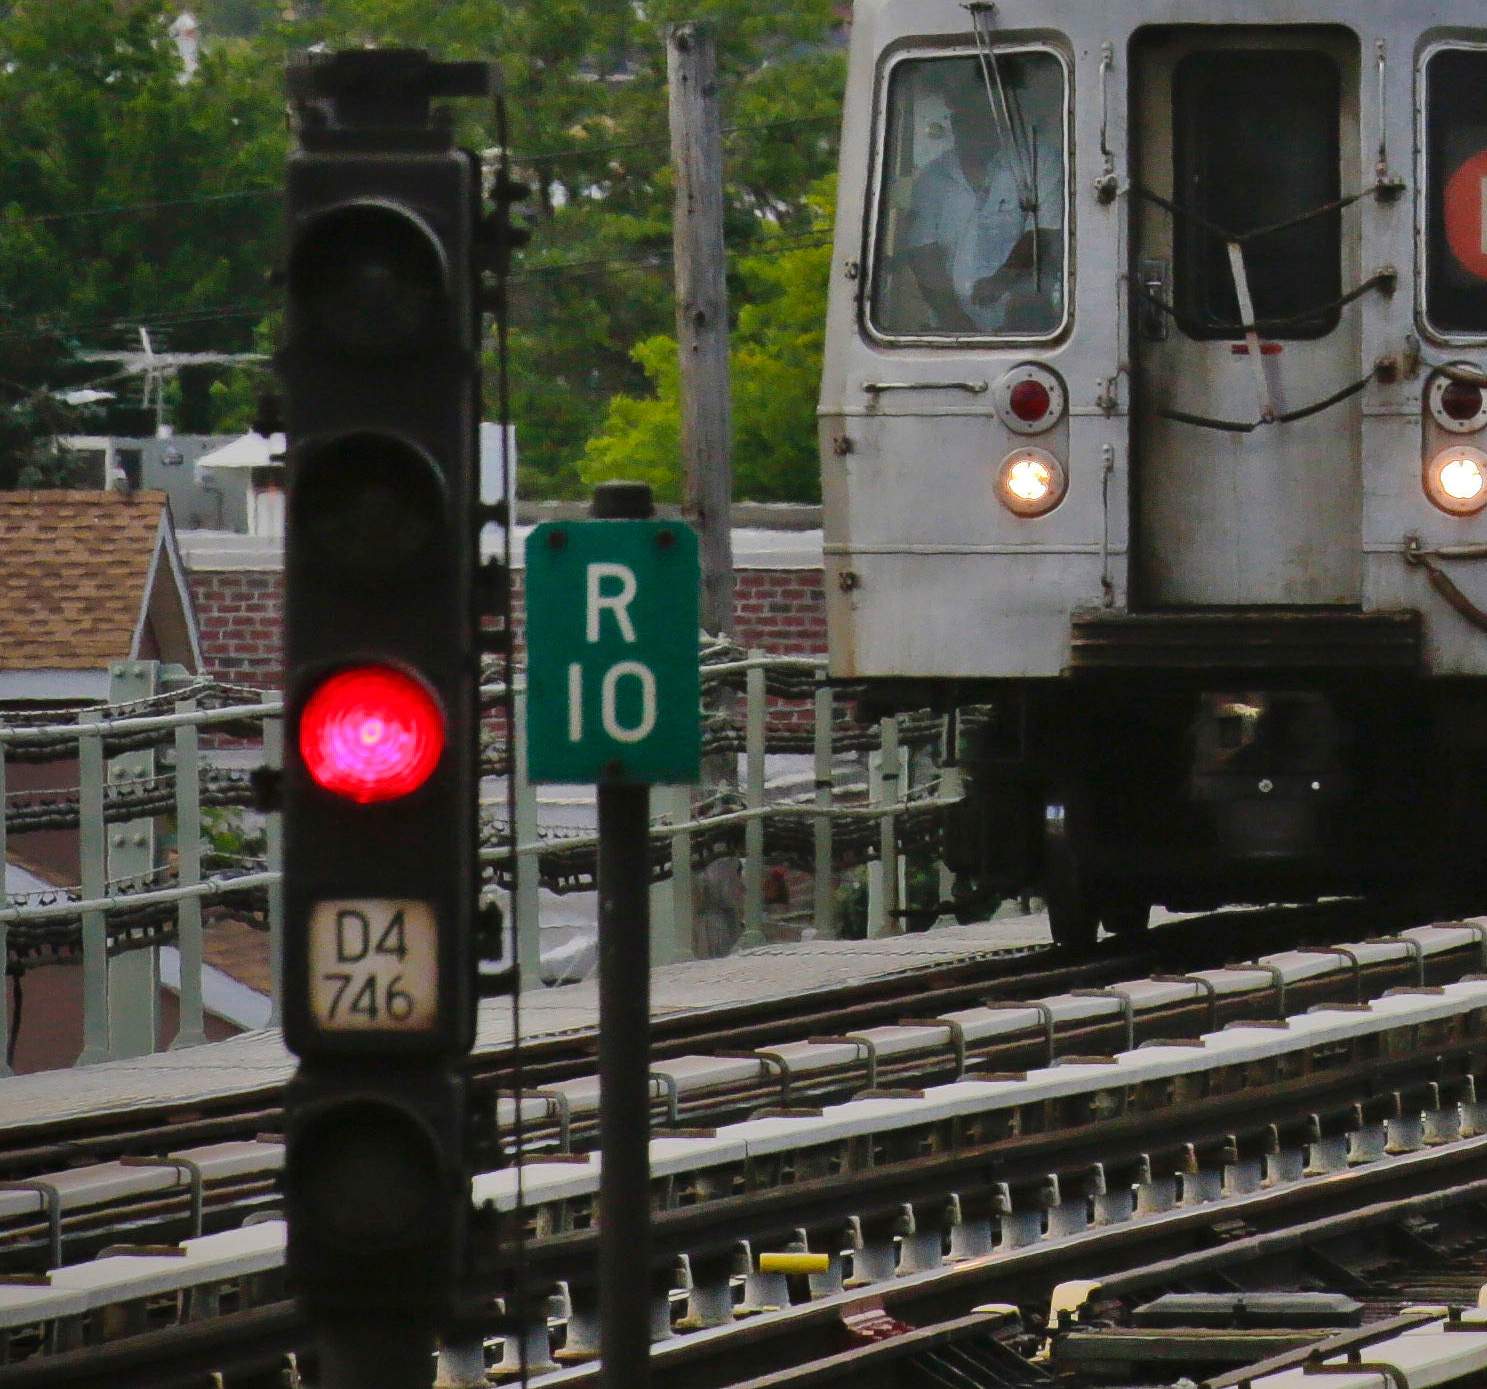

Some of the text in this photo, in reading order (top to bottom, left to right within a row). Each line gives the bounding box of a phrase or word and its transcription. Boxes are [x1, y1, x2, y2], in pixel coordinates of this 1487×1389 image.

[586, 563, 638, 643] R
[567, 661, 657, 743] 10
[336, 909, 408, 963] D4
[324, 975, 413, 1022] 746
